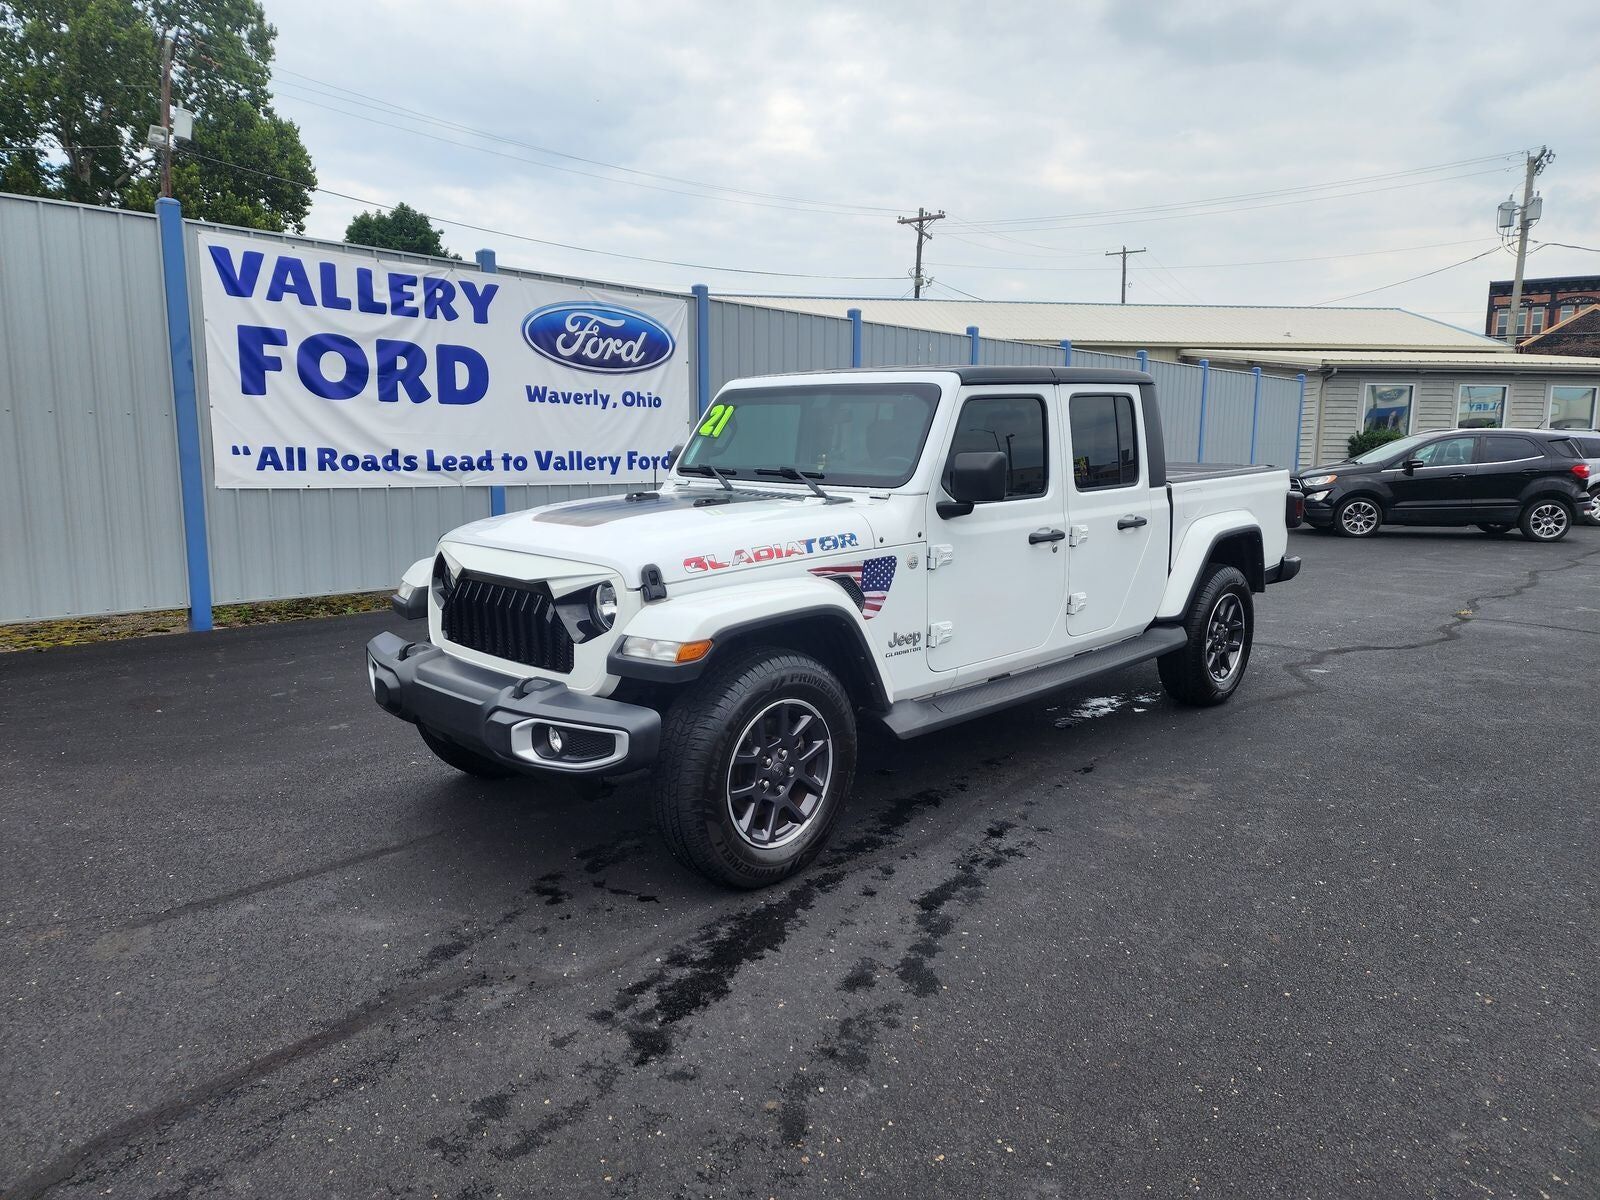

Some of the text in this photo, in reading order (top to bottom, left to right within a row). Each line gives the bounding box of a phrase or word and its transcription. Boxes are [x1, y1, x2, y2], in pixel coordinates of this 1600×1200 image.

[207, 245, 500, 325] VALLERY
[556, 312, 648, 363] Ford
[236, 324, 490, 406] FORD
[525, 384, 662, 410] Waverly, Ohio
[699, 404, 734, 438] 21
[316, 447, 419, 473] Roads
[426, 449, 495, 473] Lead
[500, 452, 528, 472] to
[533, 450, 622, 476] Vallery
[683, 532, 859, 574] GLADIATOR
[885, 646, 922, 659] GLADIATOR
[888, 631, 922, 649] Jeep
